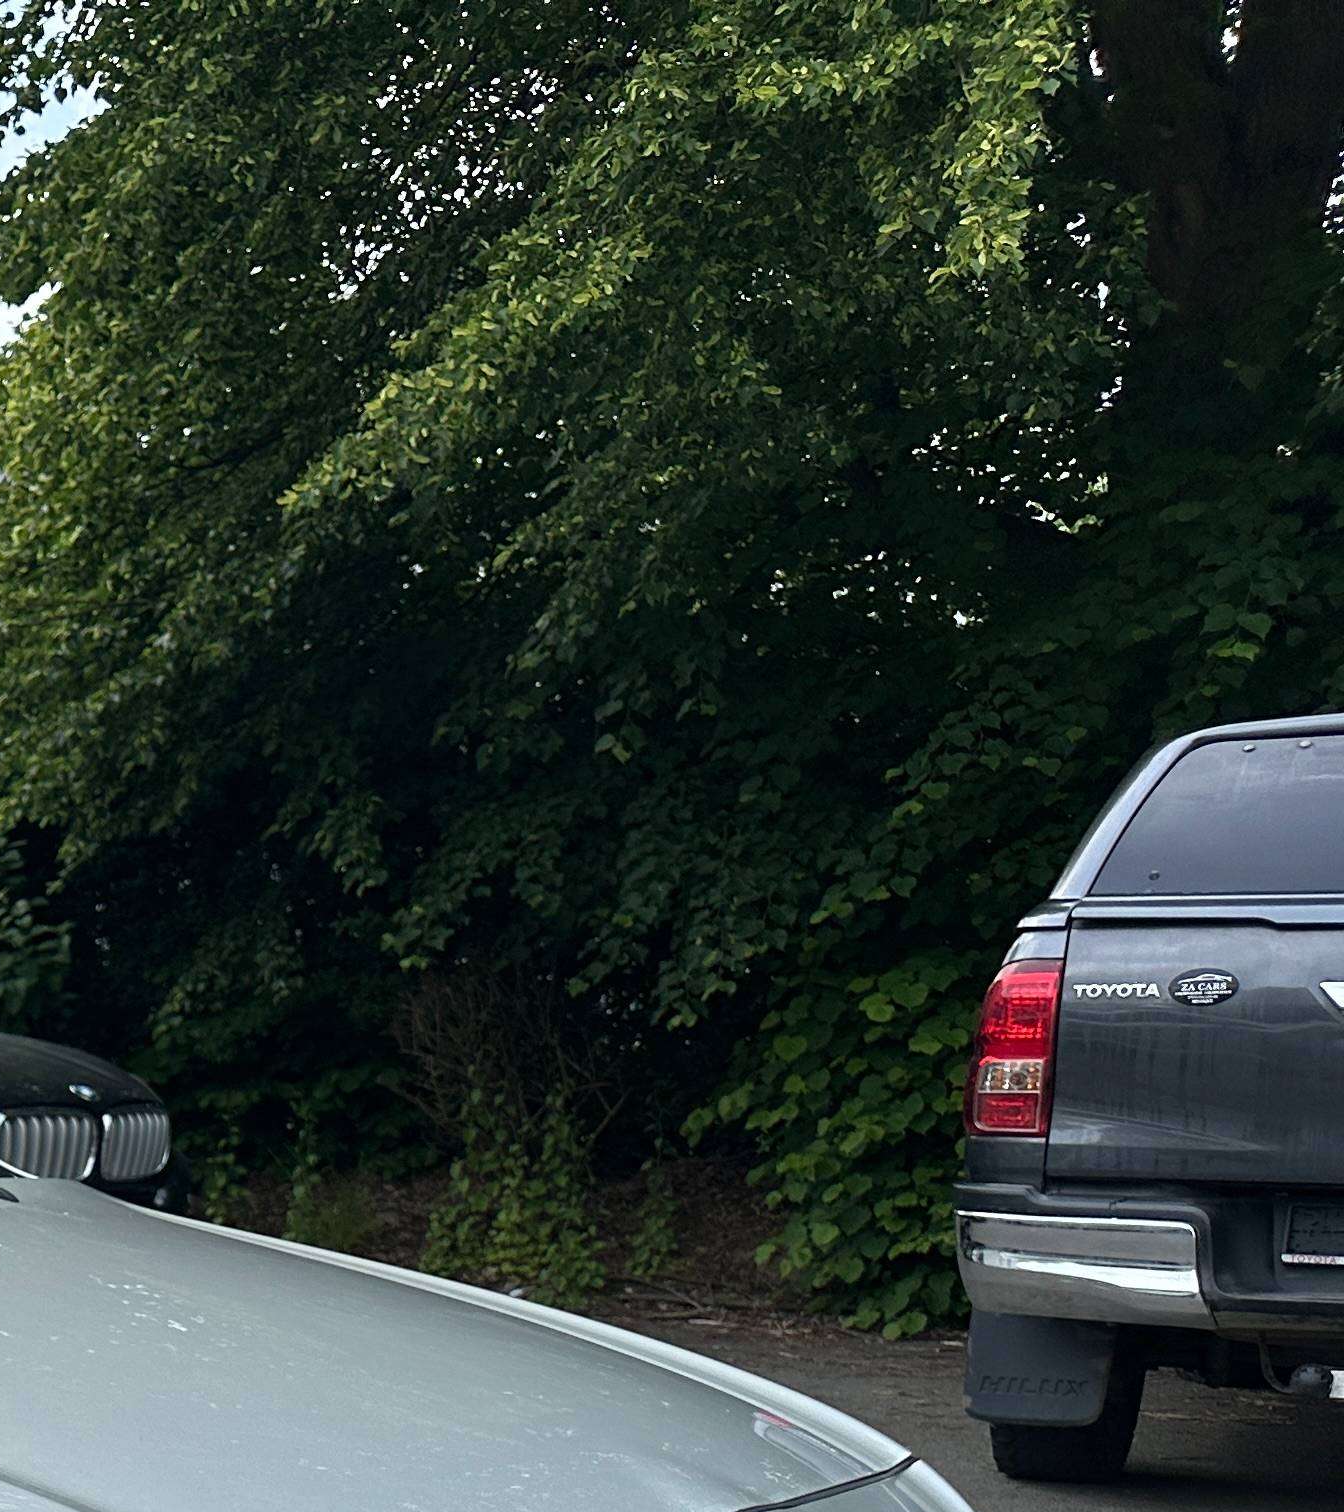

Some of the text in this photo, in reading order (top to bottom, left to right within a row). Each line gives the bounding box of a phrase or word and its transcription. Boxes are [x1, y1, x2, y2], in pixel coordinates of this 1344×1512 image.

[1072, 982, 1161, 999] TOYOTA
[1180, 981, 1227, 992] ZA CARS
